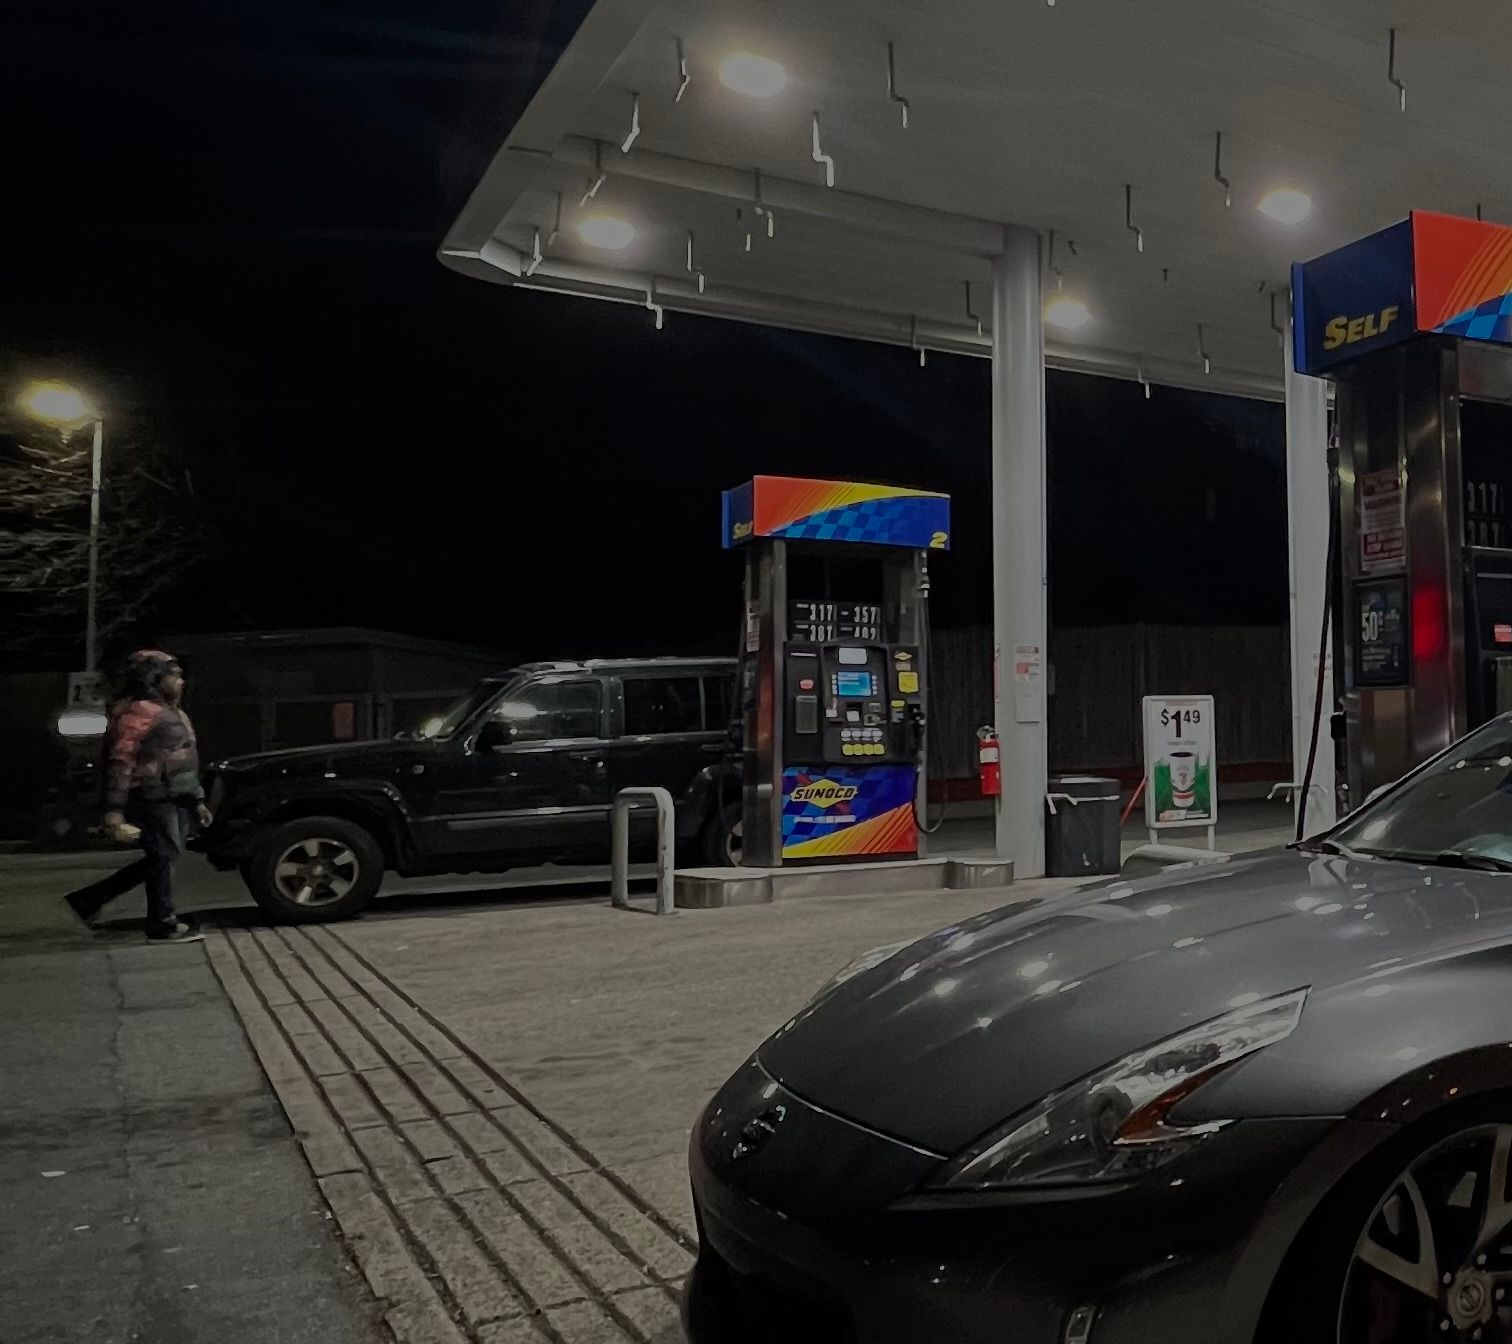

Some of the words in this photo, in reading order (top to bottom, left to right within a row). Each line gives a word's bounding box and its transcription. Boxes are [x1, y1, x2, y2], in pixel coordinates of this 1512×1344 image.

[1322, 305, 1400, 350] SELF
[929, 531, 948, 549] 2
[793, 787, 856, 800] SUNOCO
